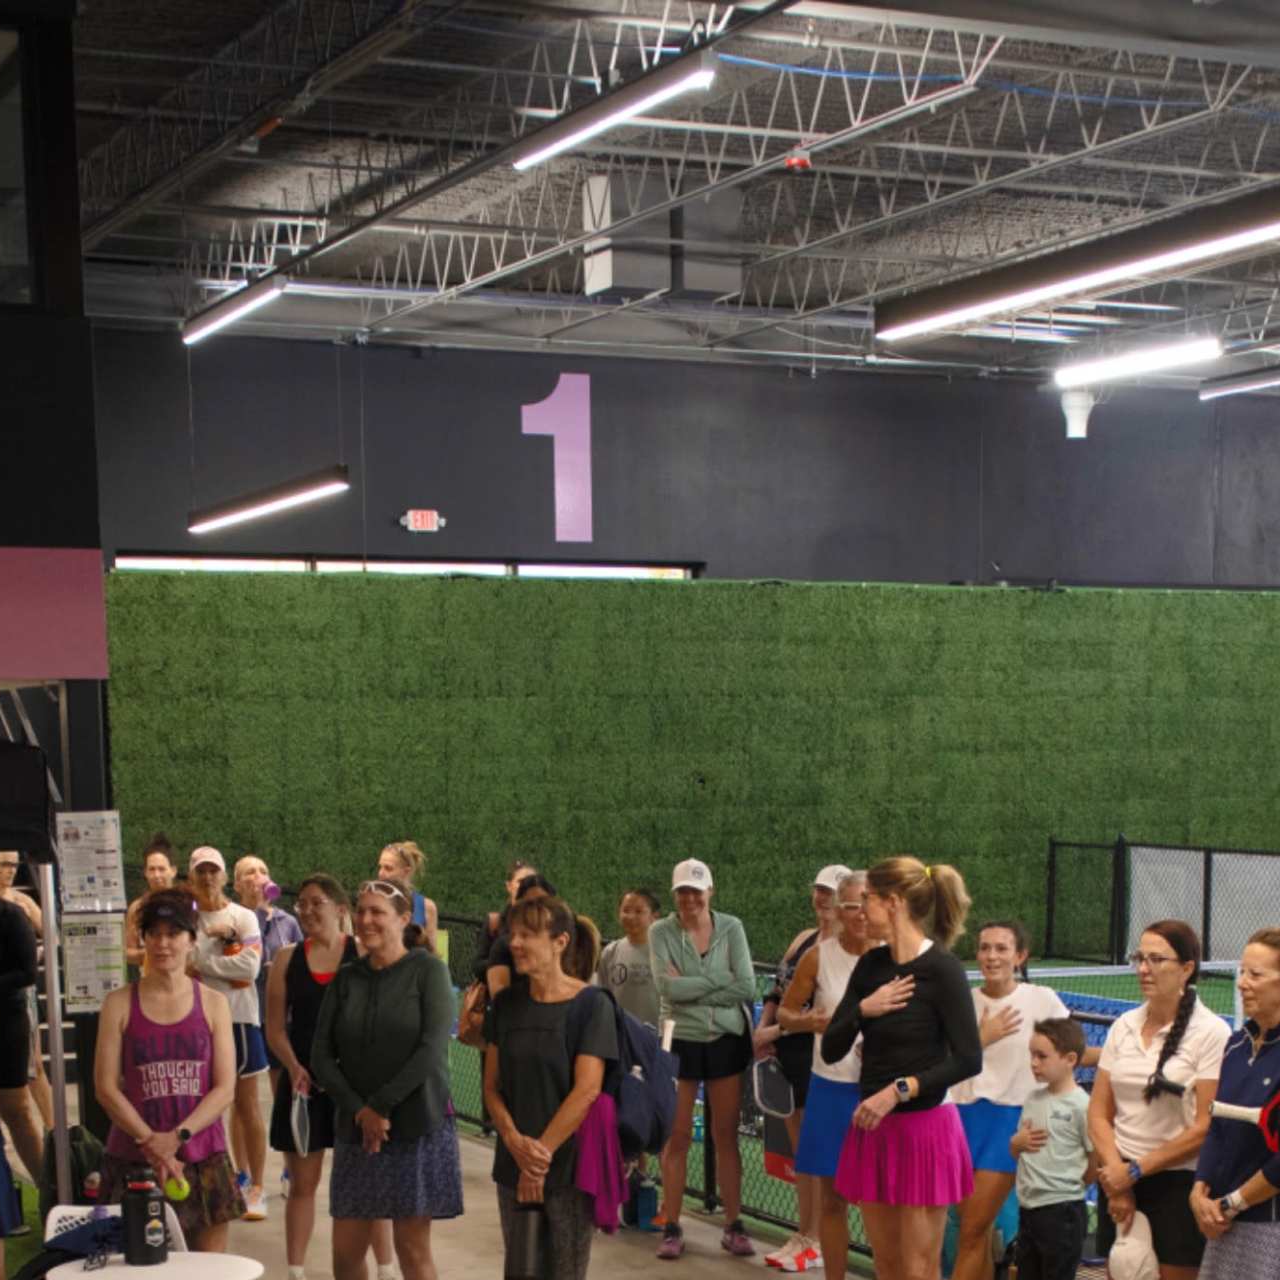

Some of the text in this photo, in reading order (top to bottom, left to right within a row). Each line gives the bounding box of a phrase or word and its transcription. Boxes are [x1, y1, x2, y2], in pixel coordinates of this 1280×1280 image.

[520, 372, 593, 543] 1
[141, 1061, 202, 1081] THOUGHT
[142, 1077, 201, 1097] YOU SAID
